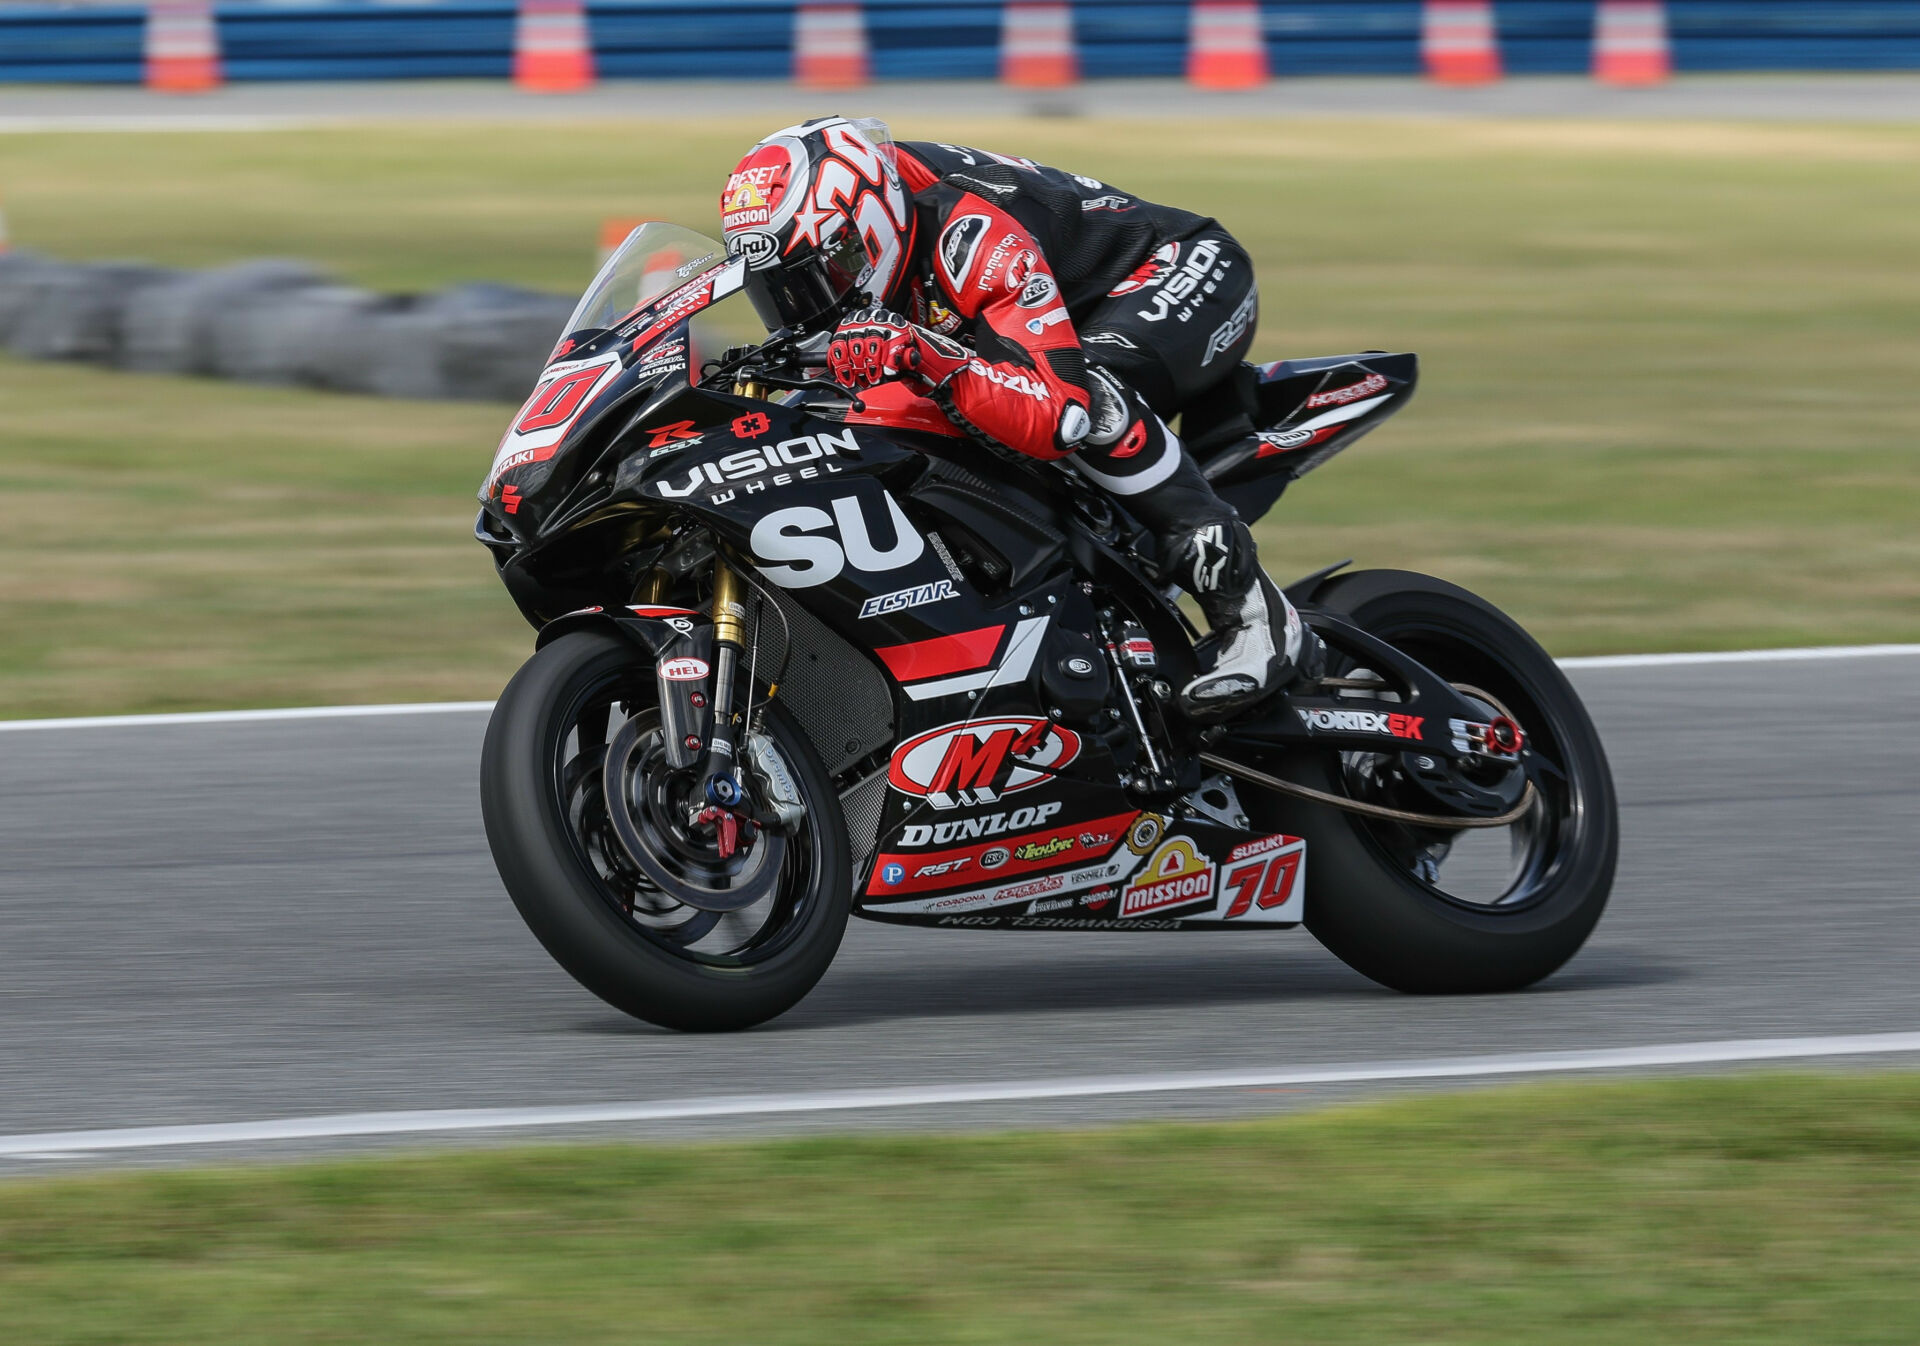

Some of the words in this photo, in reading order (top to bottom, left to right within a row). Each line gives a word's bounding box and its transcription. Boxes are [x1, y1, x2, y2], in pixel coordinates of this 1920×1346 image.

[727, 164, 781, 192] RESET
[734, 234, 769, 256] Arai
[1024, 280, 1050, 301] R&G
[1137, 239, 1222, 322] VISION
[1177, 260, 1232, 323] WHEEL
[656, 301, 705, 329] WHEEL
[638, 363, 686, 379] SUZUKI
[650, 435, 705, 458] GSX
[656, 428, 861, 498] VISION
[710, 463, 843, 506] WHEEL
[750, 489, 925, 589] SU
[858, 579, 961, 619] ECSTAR
[668, 666, 703, 677] HEL
[926, 719, 1053, 810] M4
[897, 801, 1062, 848] DUNLOP
[1231, 833, 1284, 861] SUZUKI
[887, 866, 903, 883] P
[913, 857, 972, 878] RST
[1223, 848, 1303, 919] 70
